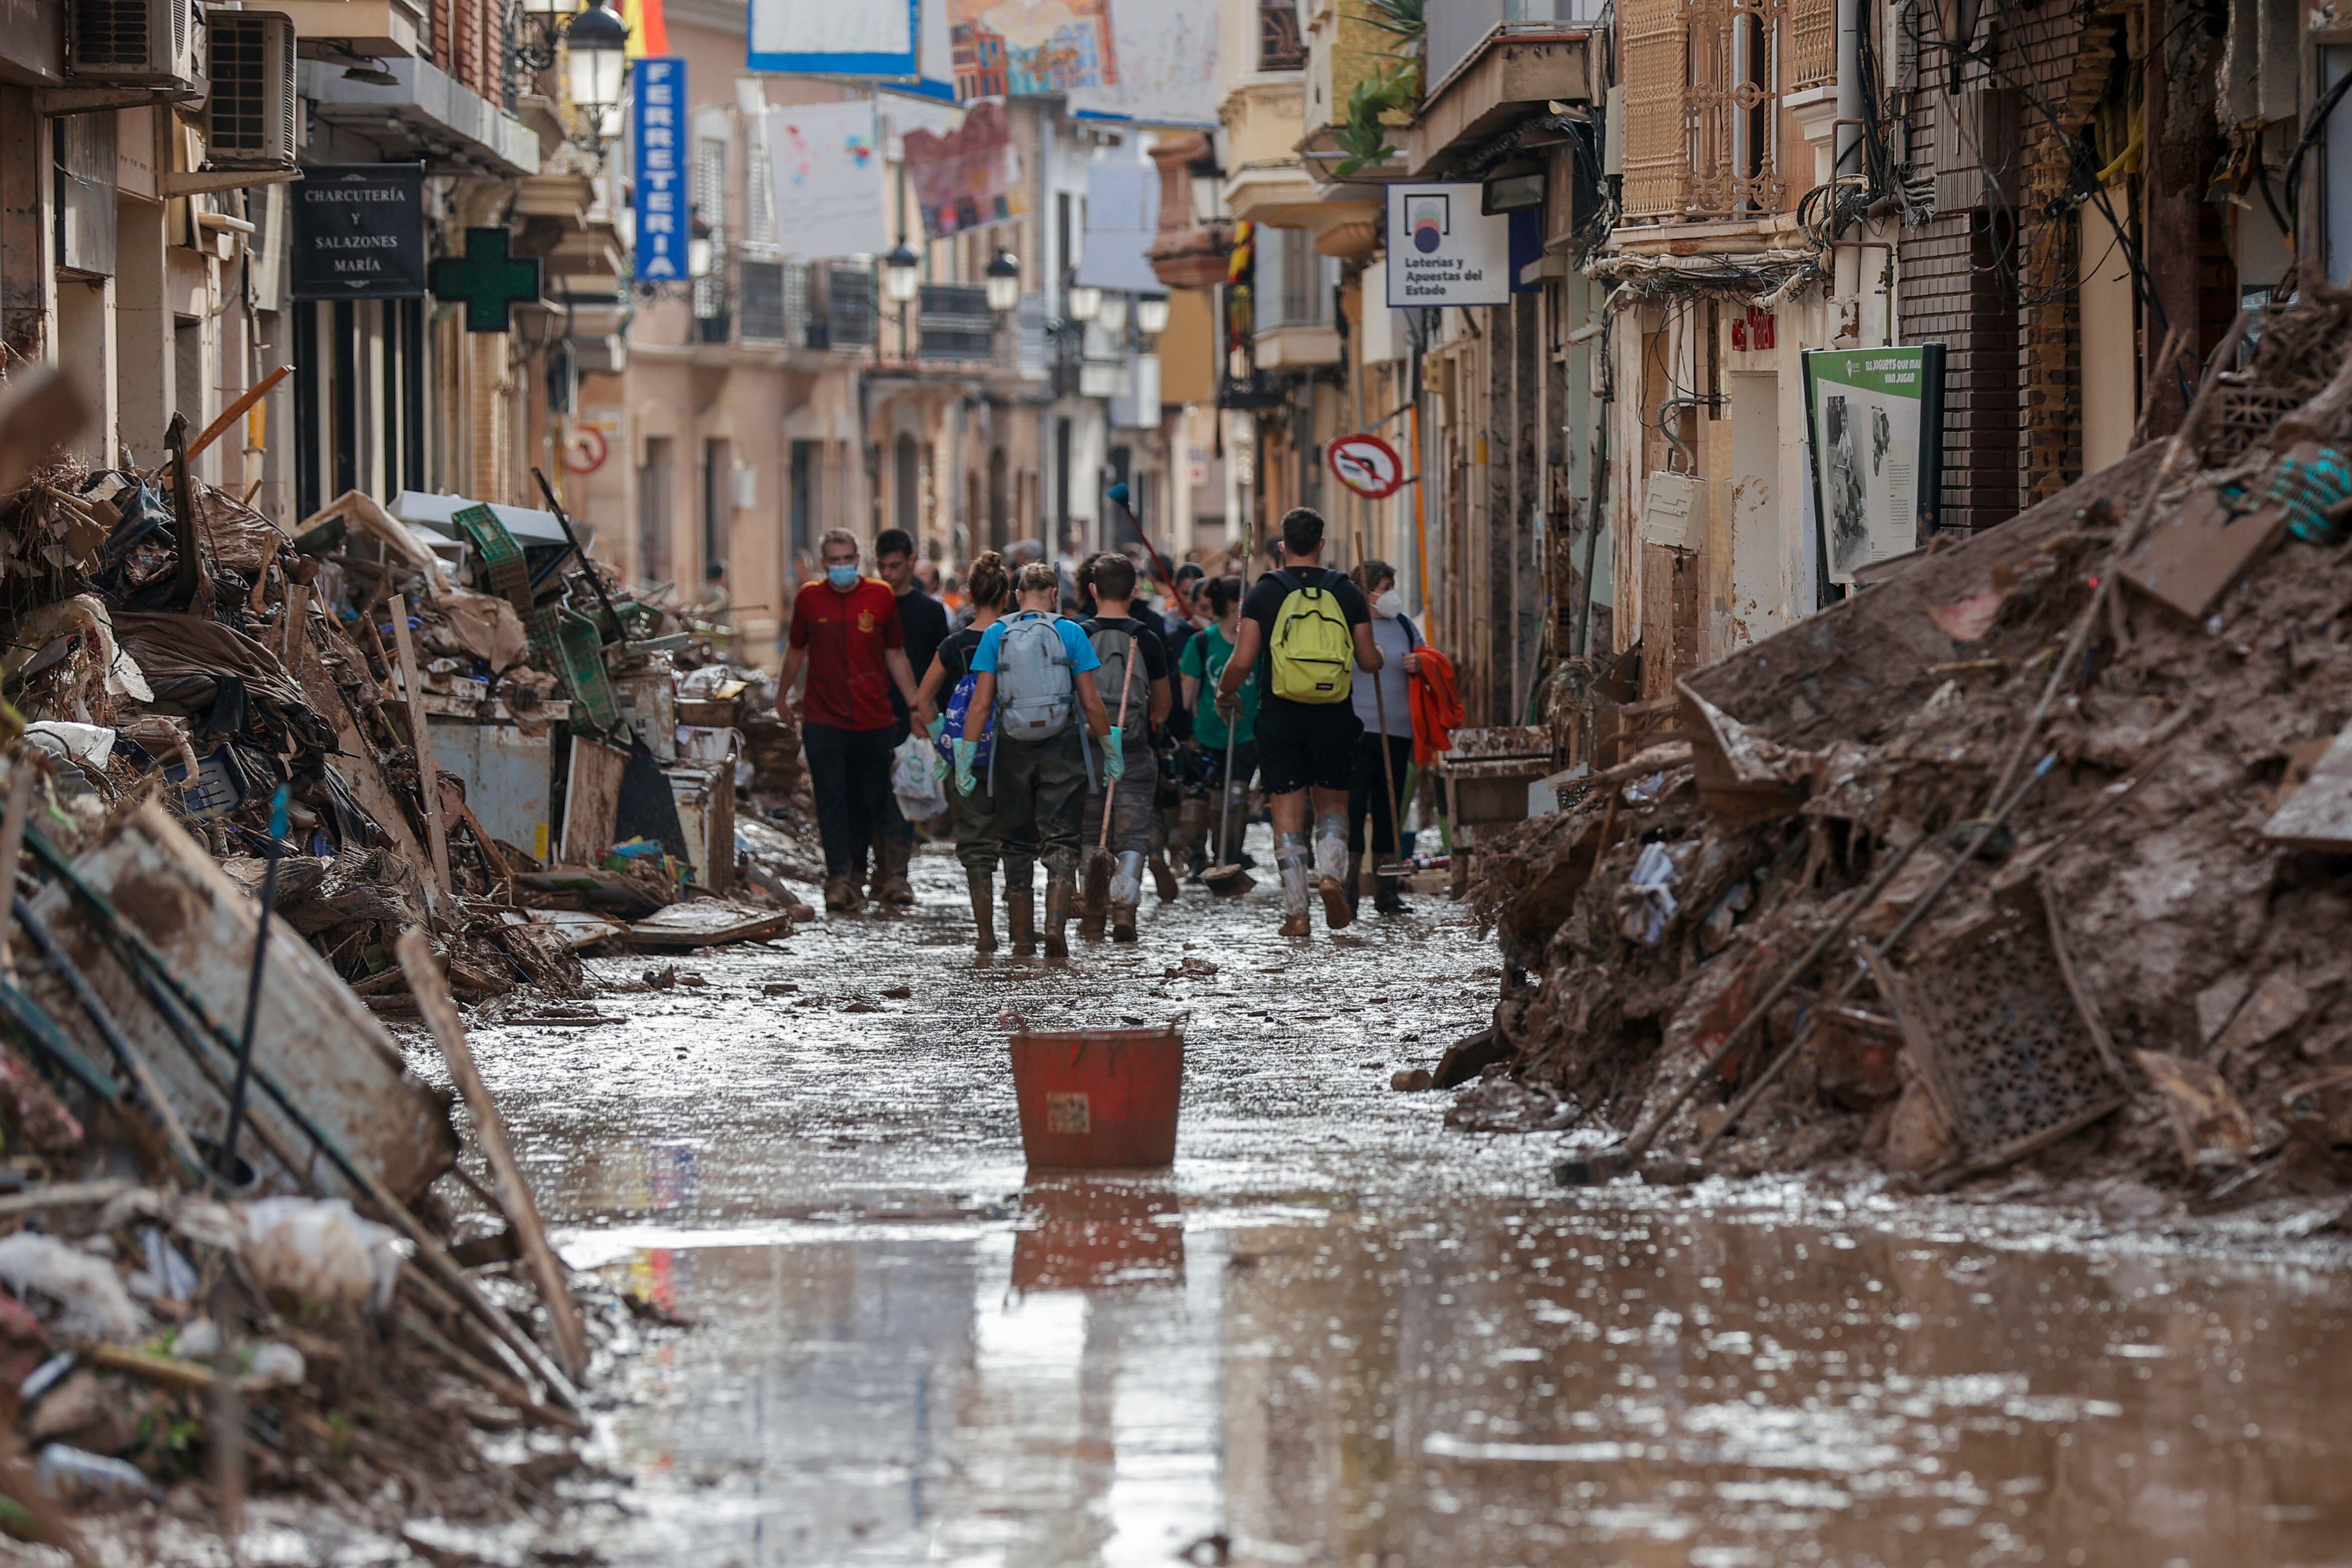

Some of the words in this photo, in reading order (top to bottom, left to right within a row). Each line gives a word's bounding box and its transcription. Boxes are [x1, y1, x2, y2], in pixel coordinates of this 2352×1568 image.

[643, 62, 677, 277] FERRETERIA
[304, 187, 406, 202] CHARCUTERÍA
[351, 212, 360, 224] Y
[315, 235, 398, 249] SALAZONES
[334, 256, 381, 272] MARÍA
[1456, 259, 1464, 269] y
[1406, 271, 1461, 284] Apuestas
[1465, 269, 1483, 281] del
[1406, 284, 1446, 295] Estado
[1896, 372, 1915, 383] JUGAR
